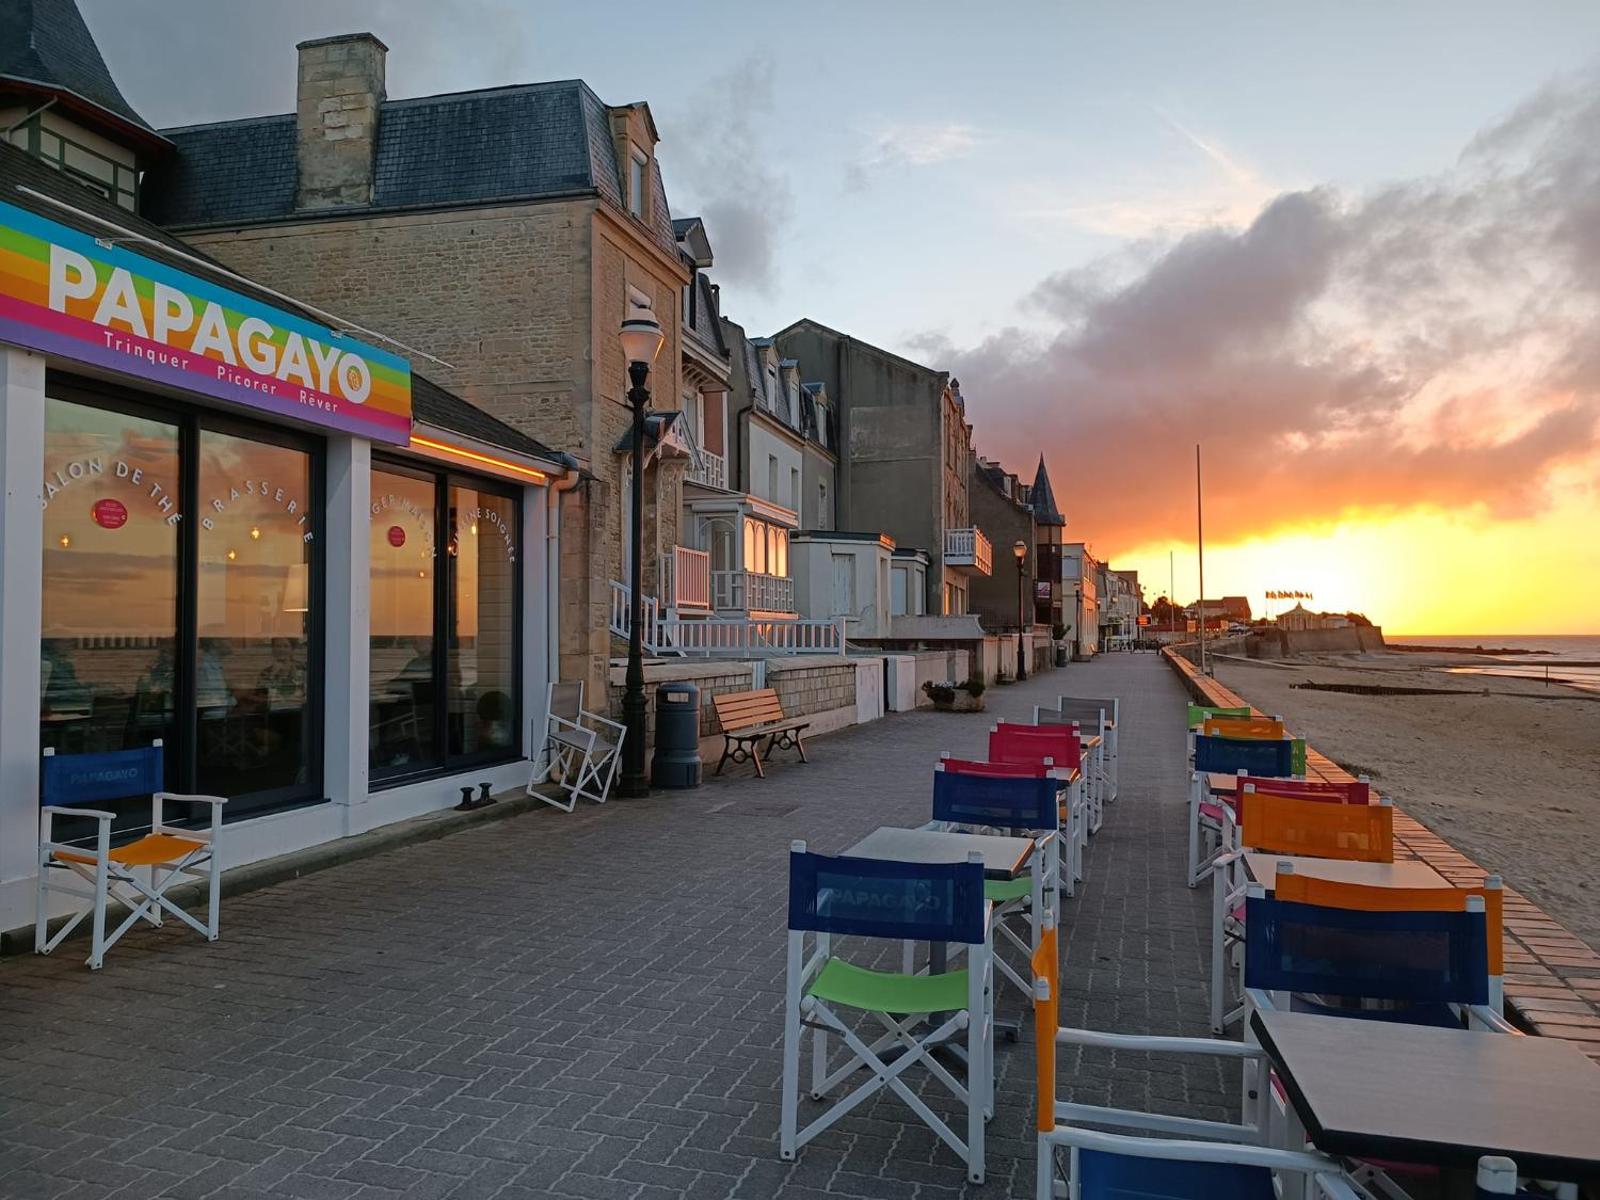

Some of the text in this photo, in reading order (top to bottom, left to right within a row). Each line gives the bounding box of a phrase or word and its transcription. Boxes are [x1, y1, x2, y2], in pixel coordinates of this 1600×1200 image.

[48, 243, 372, 404] PAPAGAYO
[104, 331, 339, 414] Trinquer Picorer Rêver
[116, 461, 144, 485] DE
[202, 480, 314, 542] BRASSERIE
